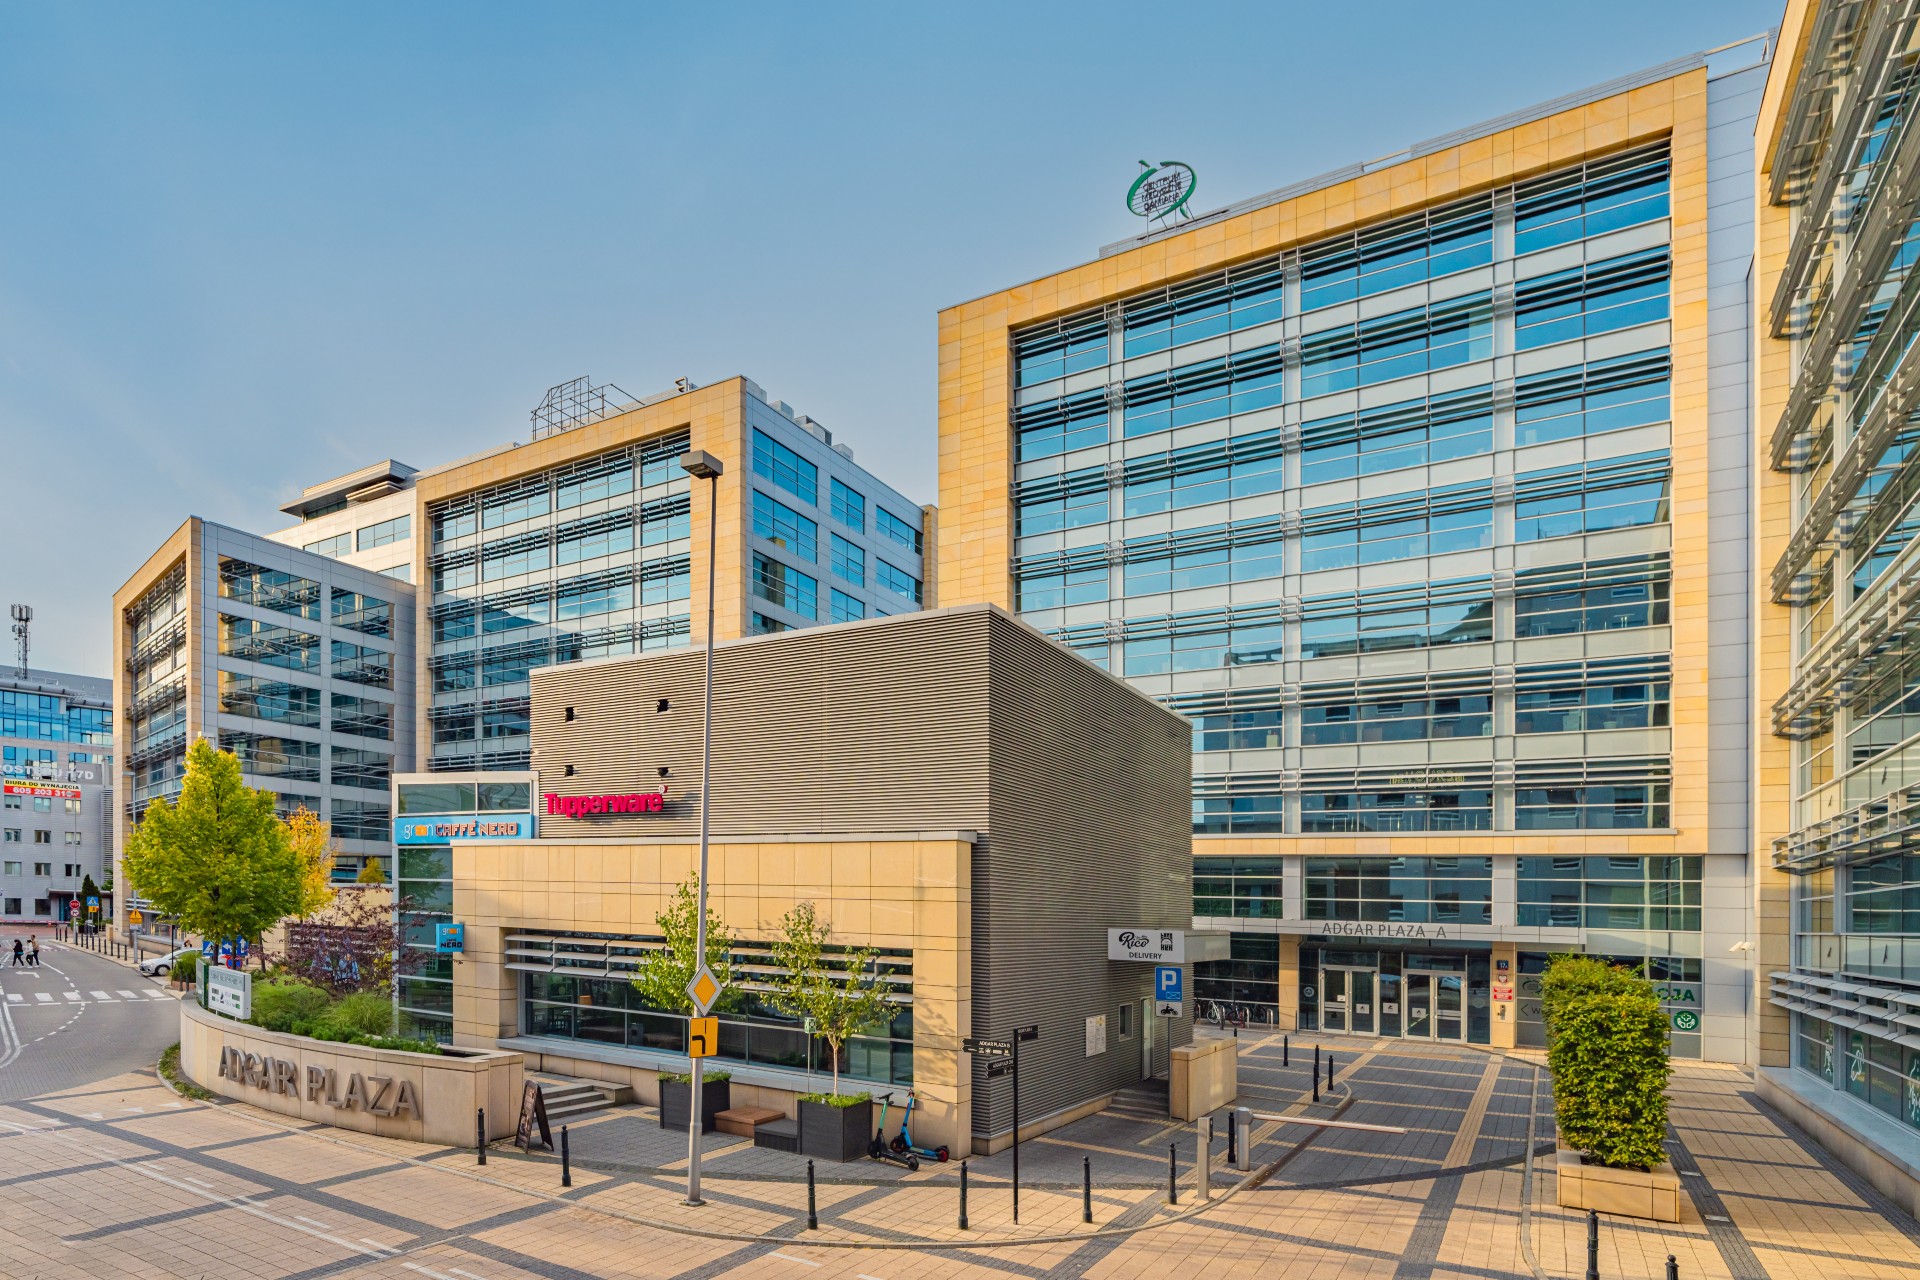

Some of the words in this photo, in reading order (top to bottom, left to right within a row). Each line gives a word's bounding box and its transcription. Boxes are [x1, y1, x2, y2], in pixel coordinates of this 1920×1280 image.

[5, 779, 27, 787] BIURA
[13, 786, 32, 794] 605
[34, 788, 52, 796] 203
[544, 793, 664, 818] Tupperware
[479, 822, 520, 836] NERO
[1322, 922, 1373, 936] ADGAR
[1378, 924, 1425, 938] PLAZA
[1436, 926, 1447, 938] A
[1119, 931, 1150, 949] Rico
[1129, 951, 1163, 960] DELIVERY
[1161, 969, 1177, 991] P
[218, 1045, 297, 1097] ADGAR
[306, 1064, 420, 1120] PLAZA
